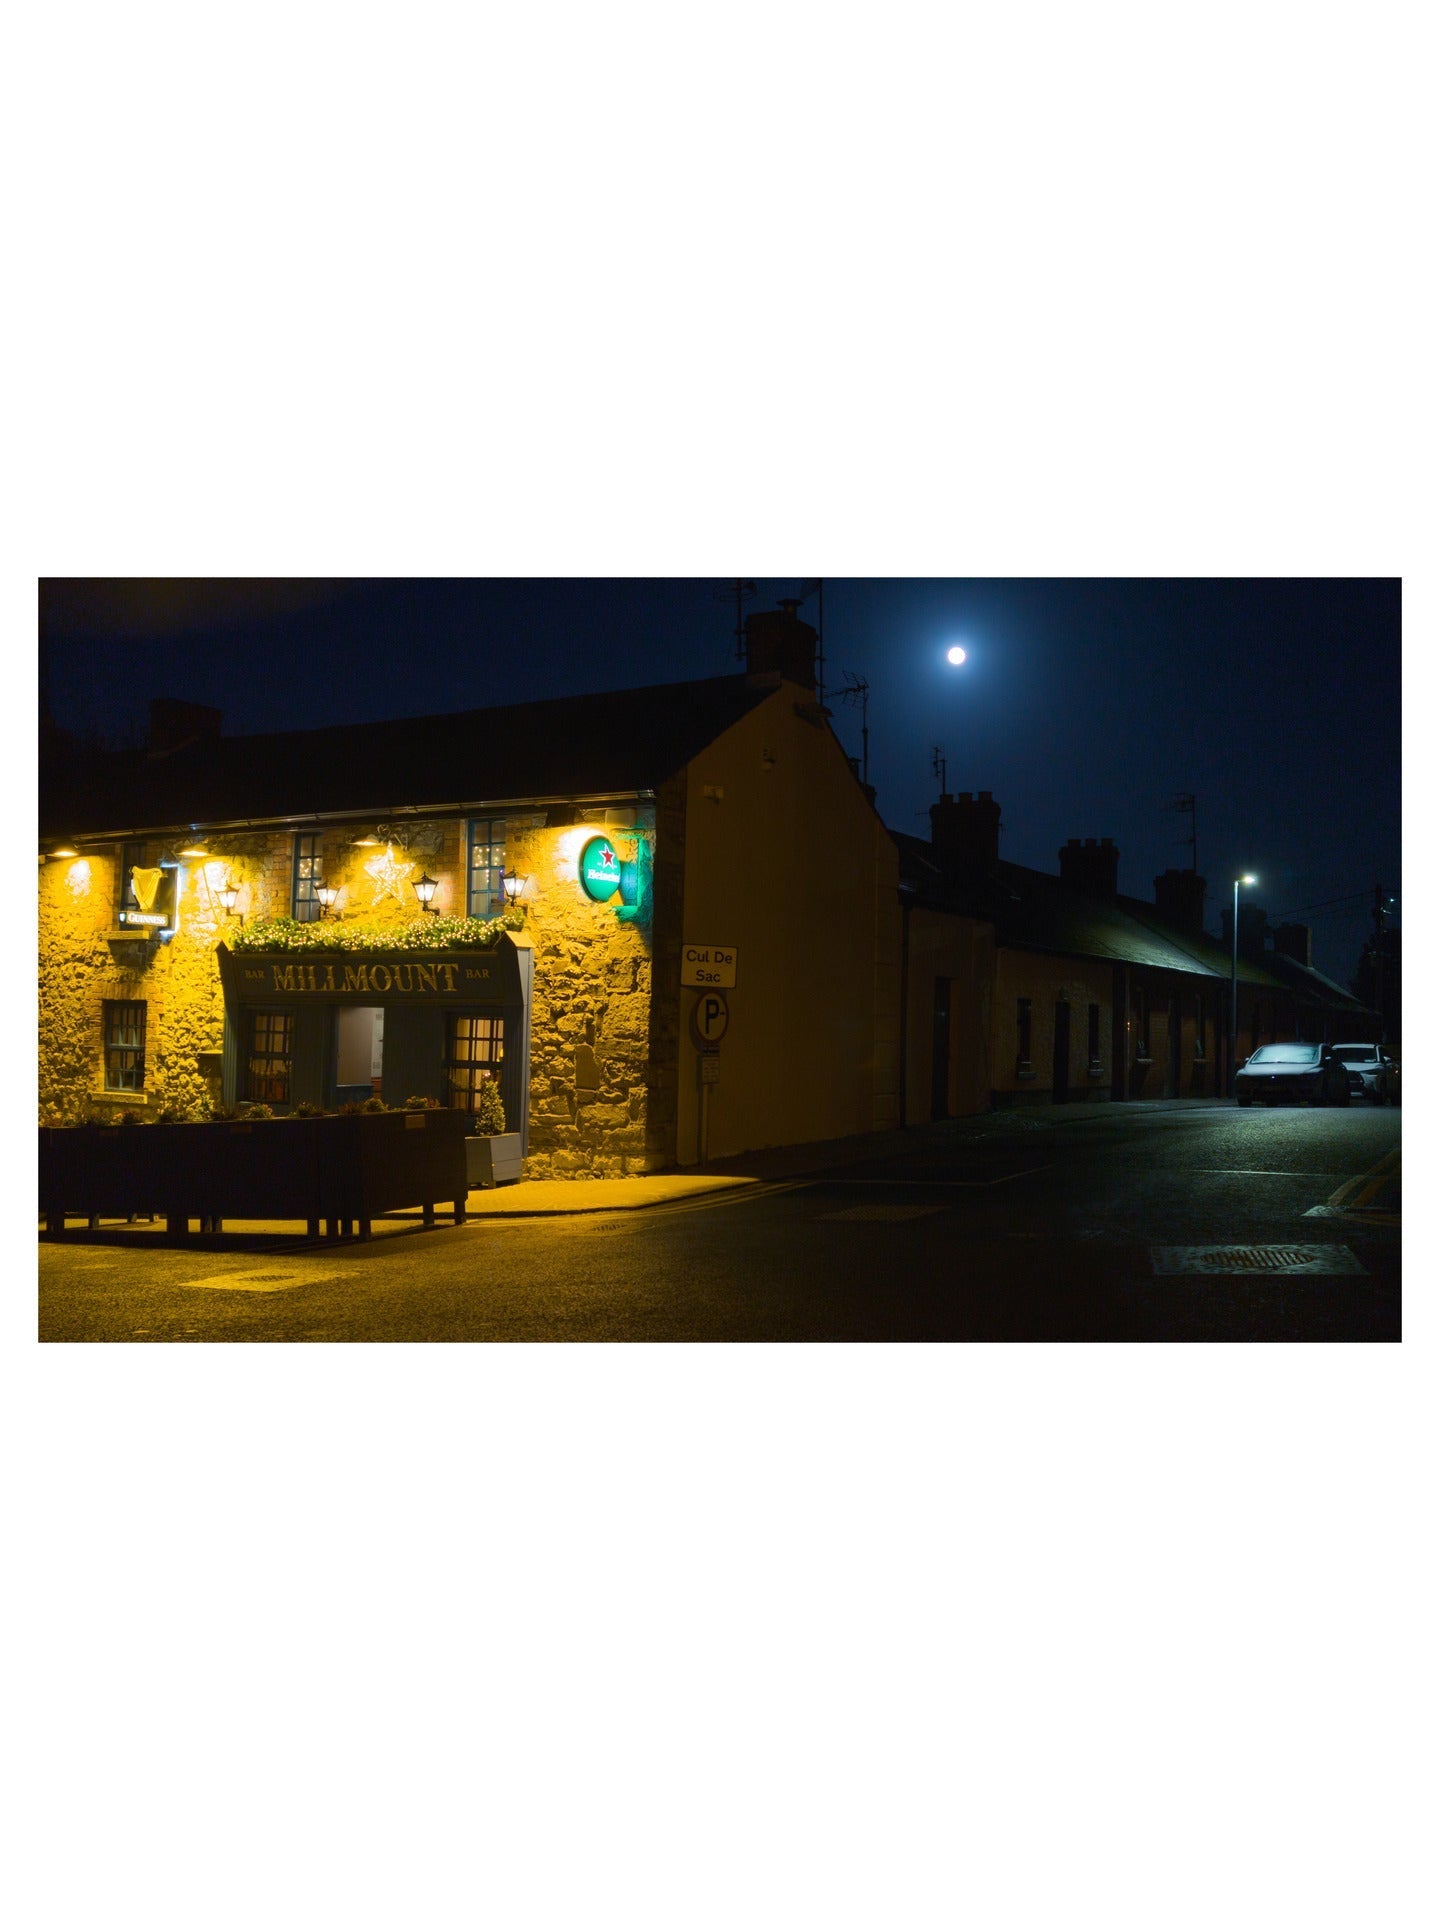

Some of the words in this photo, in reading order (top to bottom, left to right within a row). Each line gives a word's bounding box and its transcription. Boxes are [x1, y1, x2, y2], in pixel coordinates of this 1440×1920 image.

[129, 913, 165, 924] GUINNESS
[686, 949, 710, 963] Cul
[714, 951, 733, 964] De
[245, 969, 266, 980] BAR
[271, 963, 459, 992] MILLMOUNT
[466, 968, 490, 979] BAR
[696, 969, 721, 983] Sac
[705, 999, 719, 1034] P
